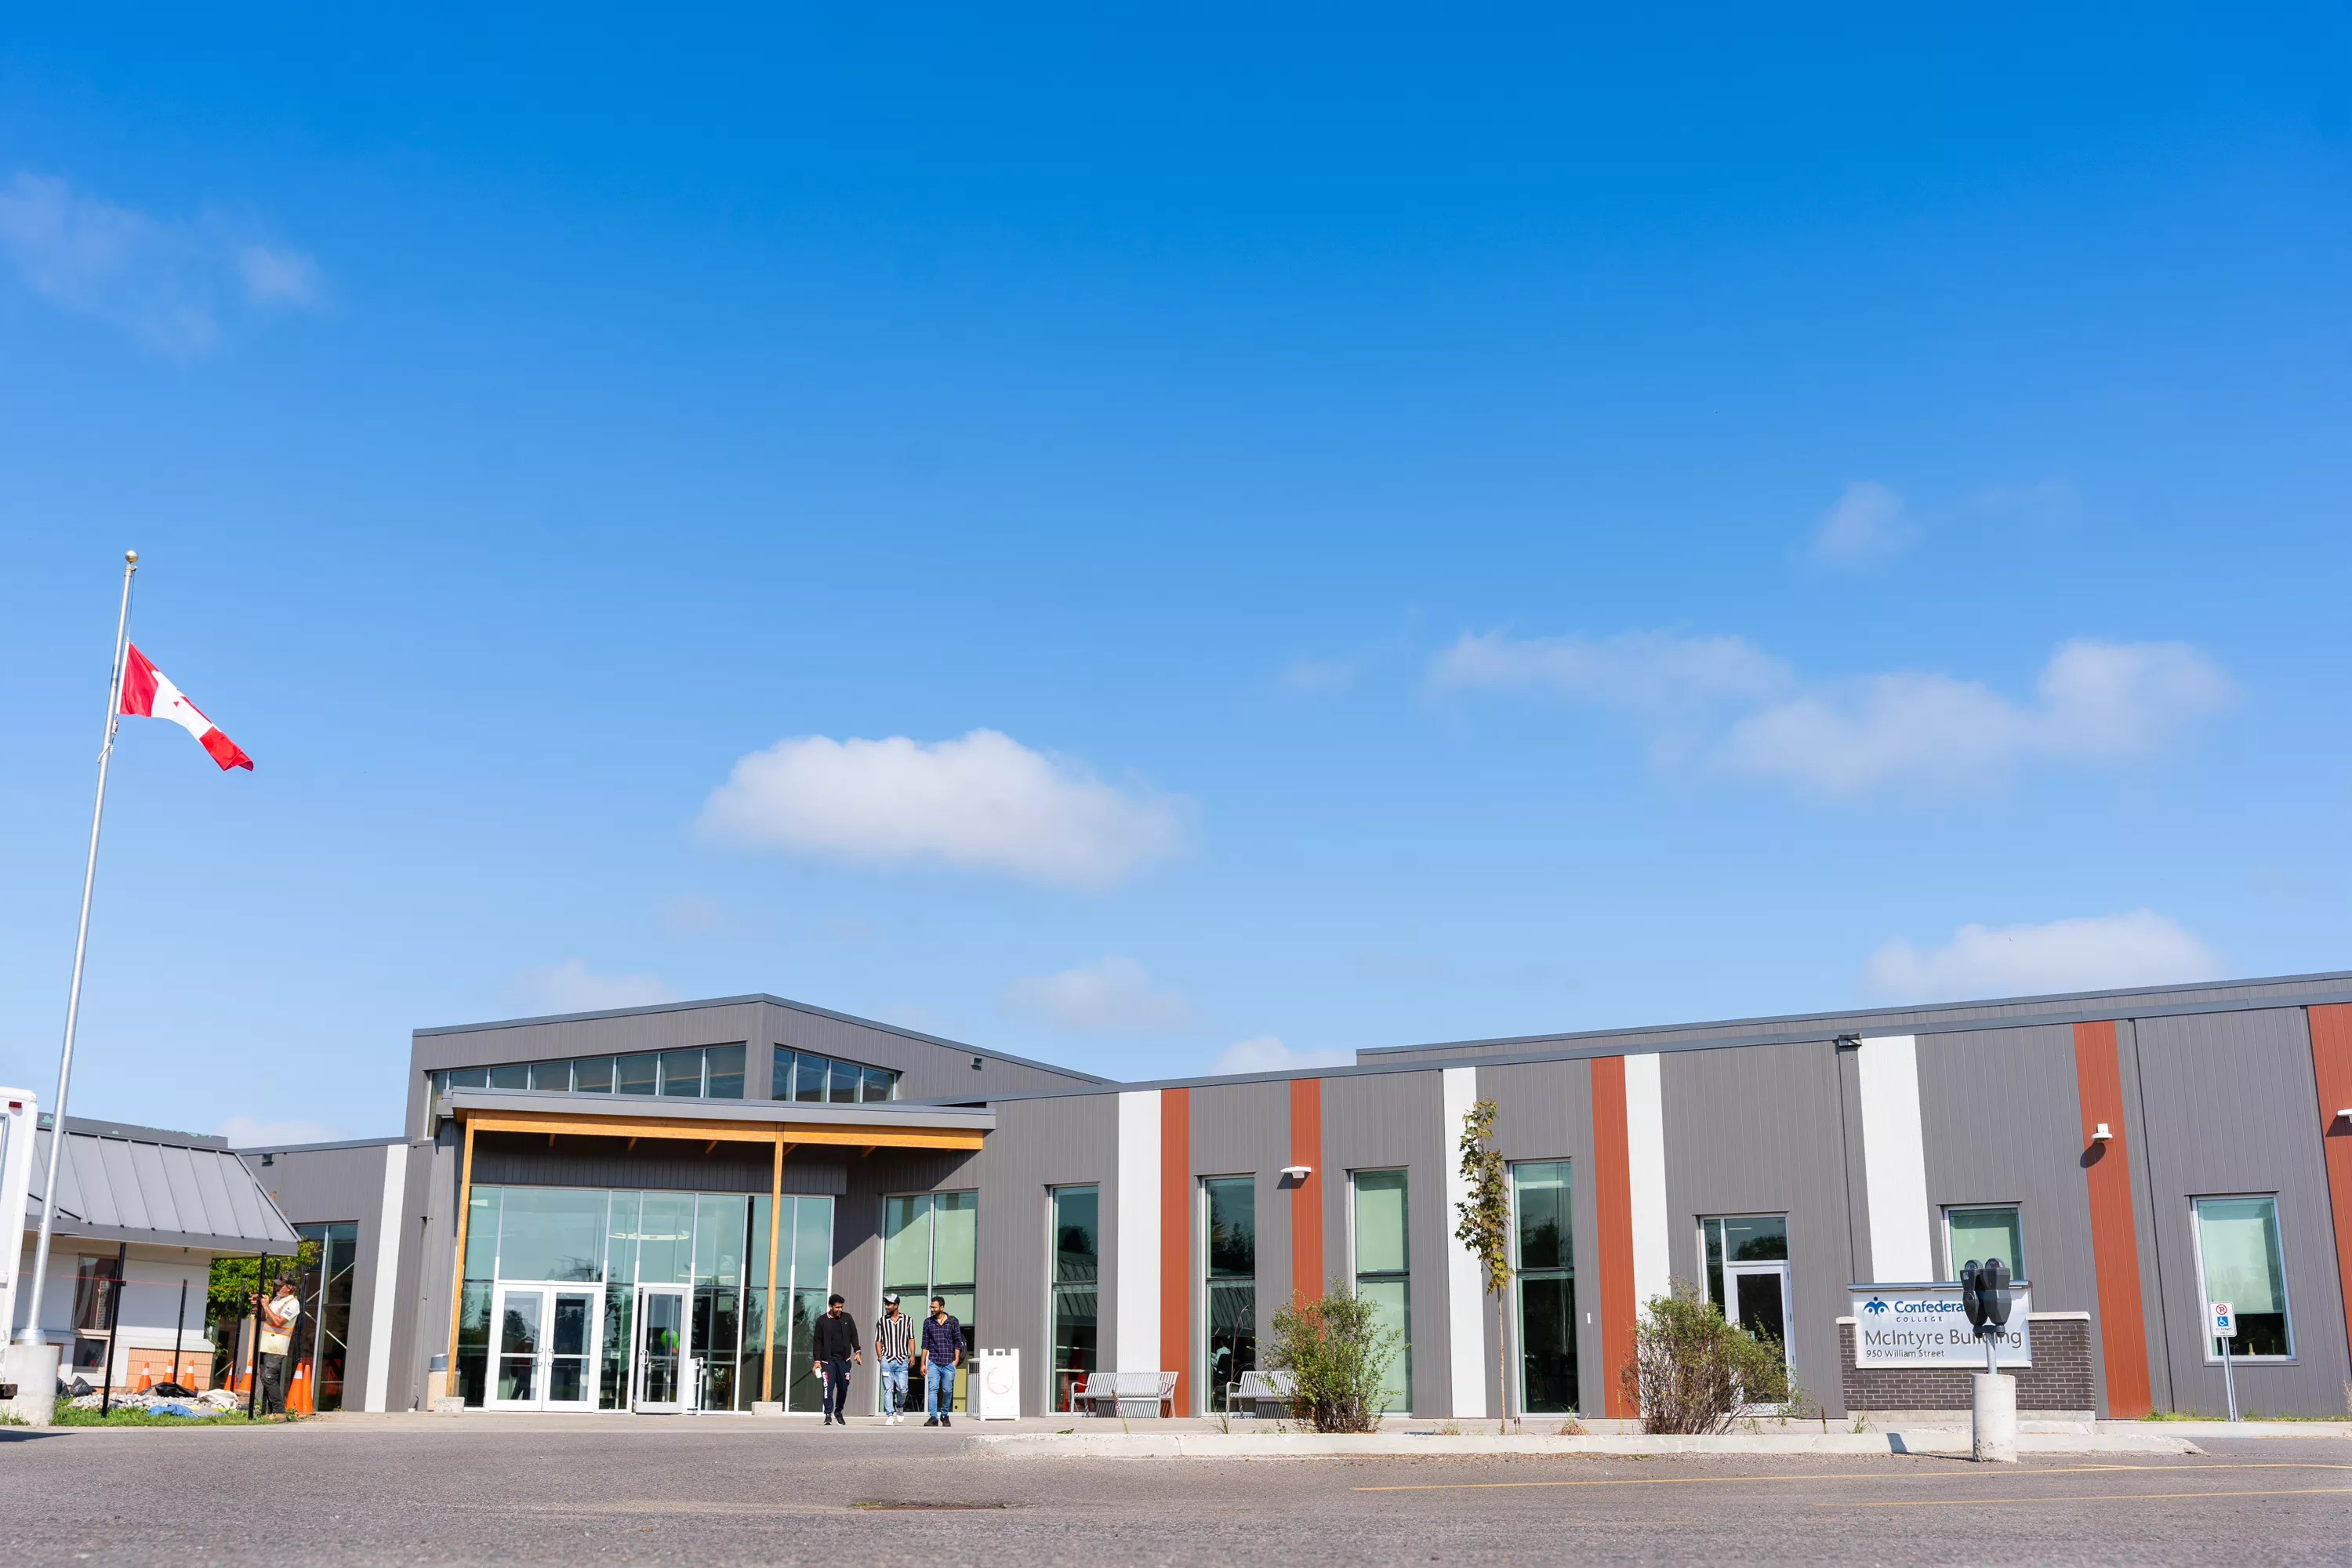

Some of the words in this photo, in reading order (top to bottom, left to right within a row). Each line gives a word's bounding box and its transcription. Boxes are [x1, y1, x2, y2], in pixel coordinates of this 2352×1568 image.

[1894, 1300, 1964, 1313] Confedera
[1865, 1330, 1944, 1349] McIntyre
[1950, 1329, 2022, 1348] Buiing
[1866, 1349, 1882, 1358] 950
[1885, 1348, 1916, 1357] William
[1918, 1348, 1944, 1357] Street
